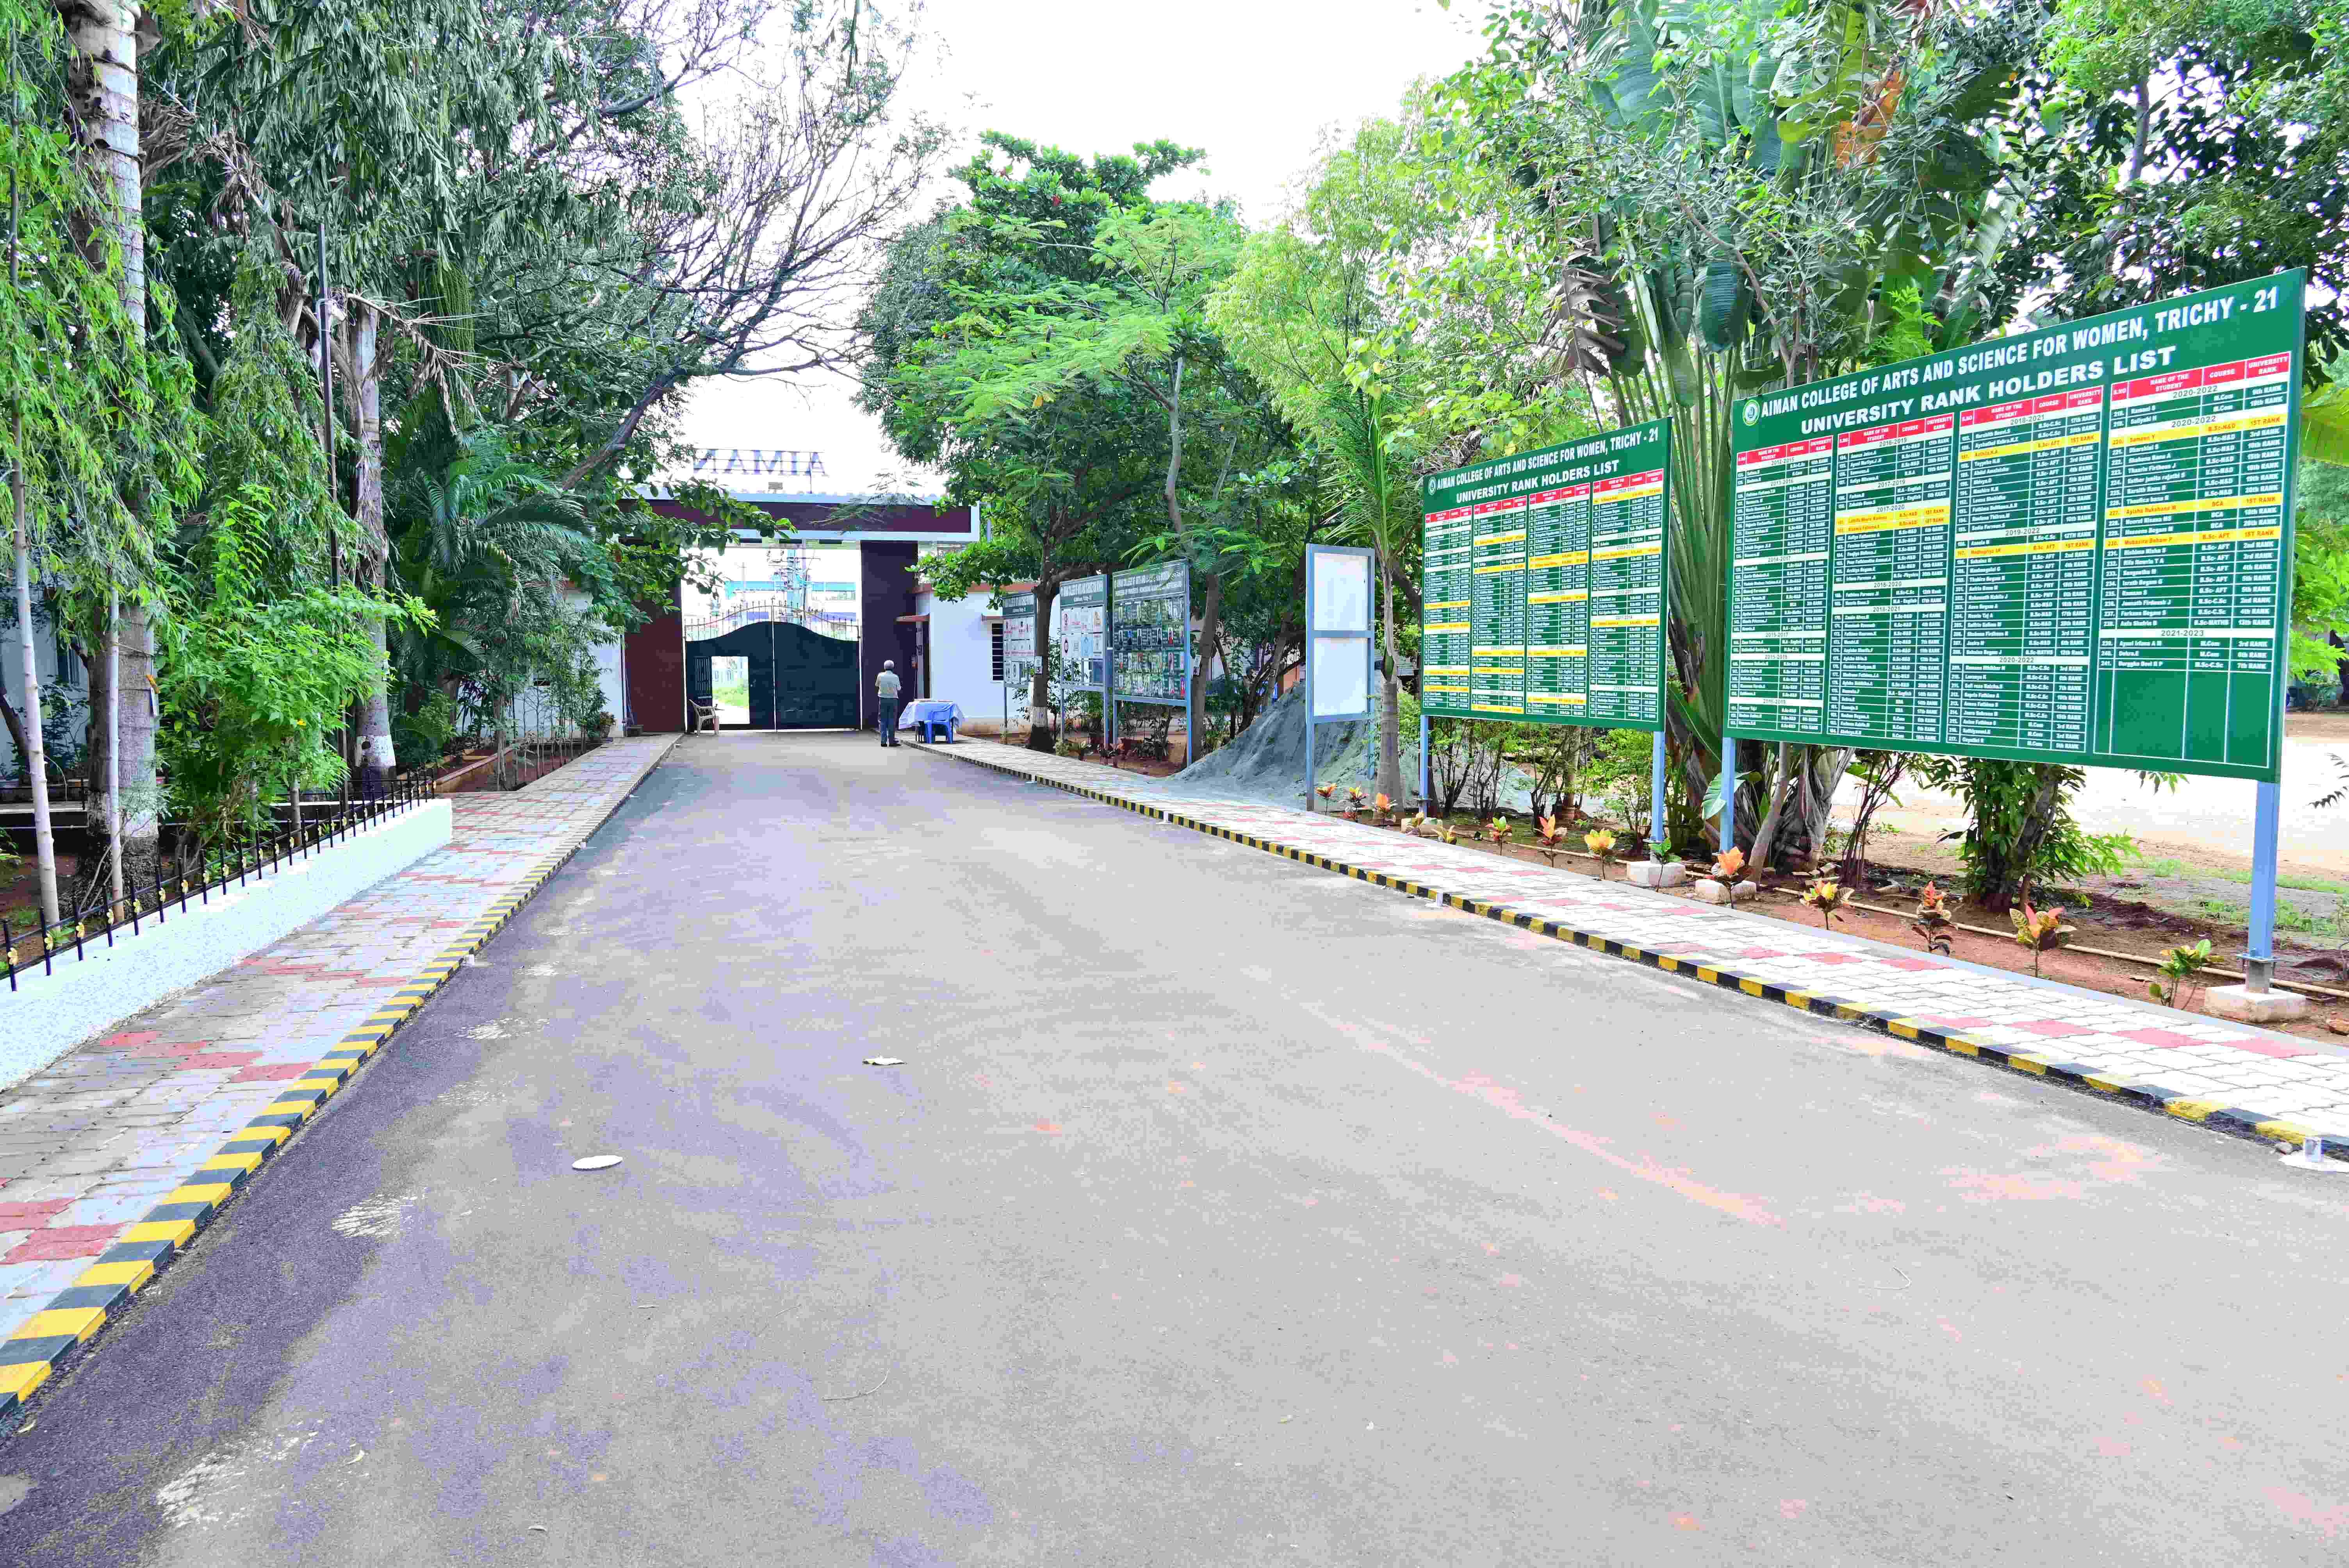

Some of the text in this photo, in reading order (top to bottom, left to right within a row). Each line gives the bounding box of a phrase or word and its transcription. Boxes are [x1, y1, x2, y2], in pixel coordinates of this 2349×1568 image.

[1762, 395, 1798, 418] AIMAN
[1801, 381, 1857, 408] COLLEGE
[1862, 376, 1878, 396] OF
[1882, 368, 1918, 392] ARTS
[1923, 360, 1953, 383] AND
[1958, 342, 2027, 375] SCIENCE
[2032, 334, 2067, 360] FOR
[2073, 316, 2148, 350] WOMEN,
[2155, 296, 2235, 333] TRICHY
[2253, 286, 2278, 312] 21
[2249, 356, 2287, 368] UNIVERSITY
[2210, 369, 2235, 378] COURSE
[1801, 346, 2176, 434] UNIVERSITY RANK HOLDERS LIST
[2155, 382, 2183, 392] STUDENT
[2173, 386, 2217, 398] 2020-2022
[2010, 415, 2044, 425] 2018-2021
[2171, 415, 2215, 428] 2020-2022
[1437, 475, 1455, 490] AIMAN
[1456, 469, 1483, 486] COLLEGE
[1485, 467, 1492, 478] OF
[1494, 463, 1511, 478] ARTS
[1512, 460, 1527, 473] AND
[1528, 452, 1558, 470] SCIENCE
[1559, 449, 1575, 463] FOR
[1577, 441, 1608, 460] WOMEN,
[1610, 432, 1641, 450] TRICHY
[1649, 427, 1659, 443] 21
[1456, 460, 1620, 503] UNIVERSITY RANK HOLDERS LIST
